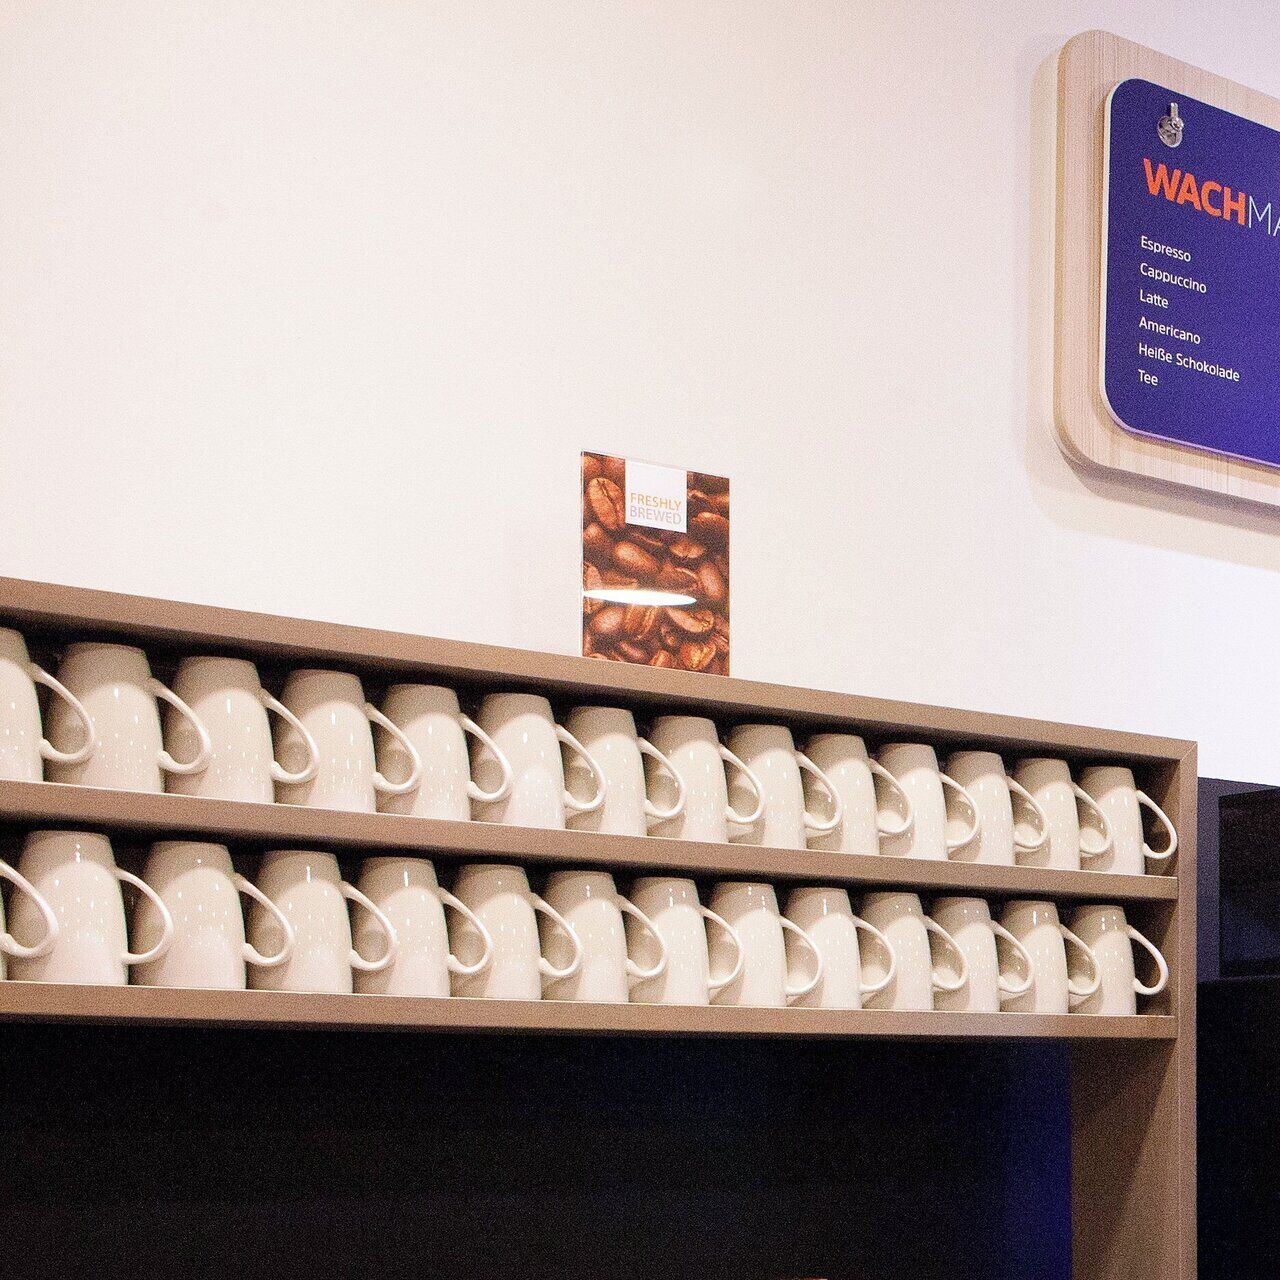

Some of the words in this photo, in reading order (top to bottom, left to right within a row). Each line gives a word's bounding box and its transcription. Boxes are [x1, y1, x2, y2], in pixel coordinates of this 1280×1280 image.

[1140, 235, 1191, 262] Espresso
[1140, 262, 1207, 294] Cappuccino
[1139, 289, 1169, 309] Latte
[1138, 316, 1201, 345] Americano
[1138, 342, 1173, 363] Heiße
[1176, 353, 1240, 382] Schokolade
[1138, 369, 1159, 386] Tee
[630, 492, 682, 511] FRESHLY
[629, 505, 682, 525] BREWED
